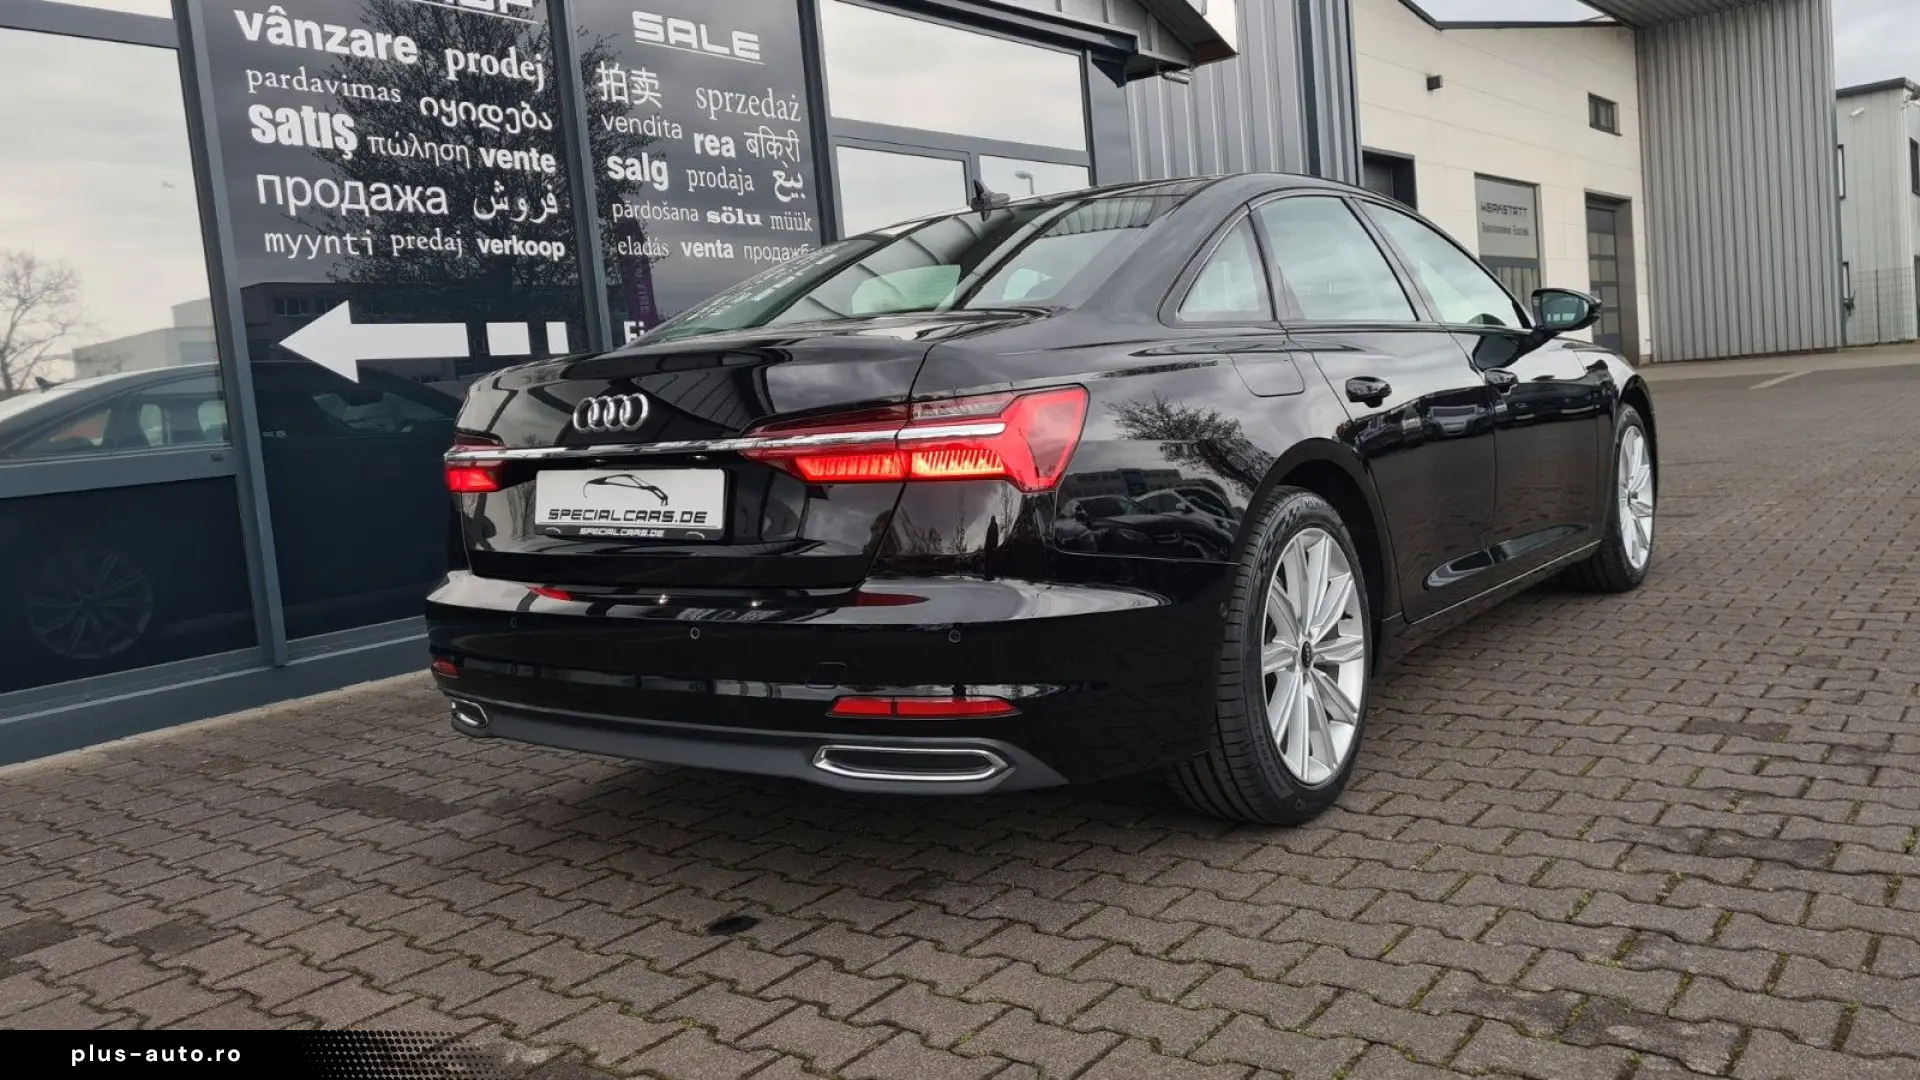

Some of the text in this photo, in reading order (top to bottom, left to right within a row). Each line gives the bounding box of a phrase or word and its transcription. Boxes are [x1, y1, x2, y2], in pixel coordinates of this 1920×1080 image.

[233, 5, 545, 92] vânzare prodej
[632, 10, 760, 60] SALE
[246, 67, 401, 103] pardavimas
[595, 60, 661, 108] 拍卖
[419, 96, 553, 133] იყიდება
[695, 86, 801, 122] sprzedaż
[248, 103, 358, 160] satış
[600, 112, 736, 158] vendita rea
[366, 132, 470, 169] πώληση
[478, 147, 557, 173] vente
[606, 152, 755, 196] salg prodaja
[256, 173, 449, 217] продажа
[473, 179, 558, 223] فروش
[706, 206, 763, 226] sölu
[769, 211, 814, 232] müük
[264, 228, 565, 261] myynti predaj verkoop
[617, 235, 734, 259] eladás venta
[743, 243, 814, 264] продажб
[548, 508, 708, 524] SPECIALCARS.DE
[579, 527, 665, 538] SPECIALCARS.DE
